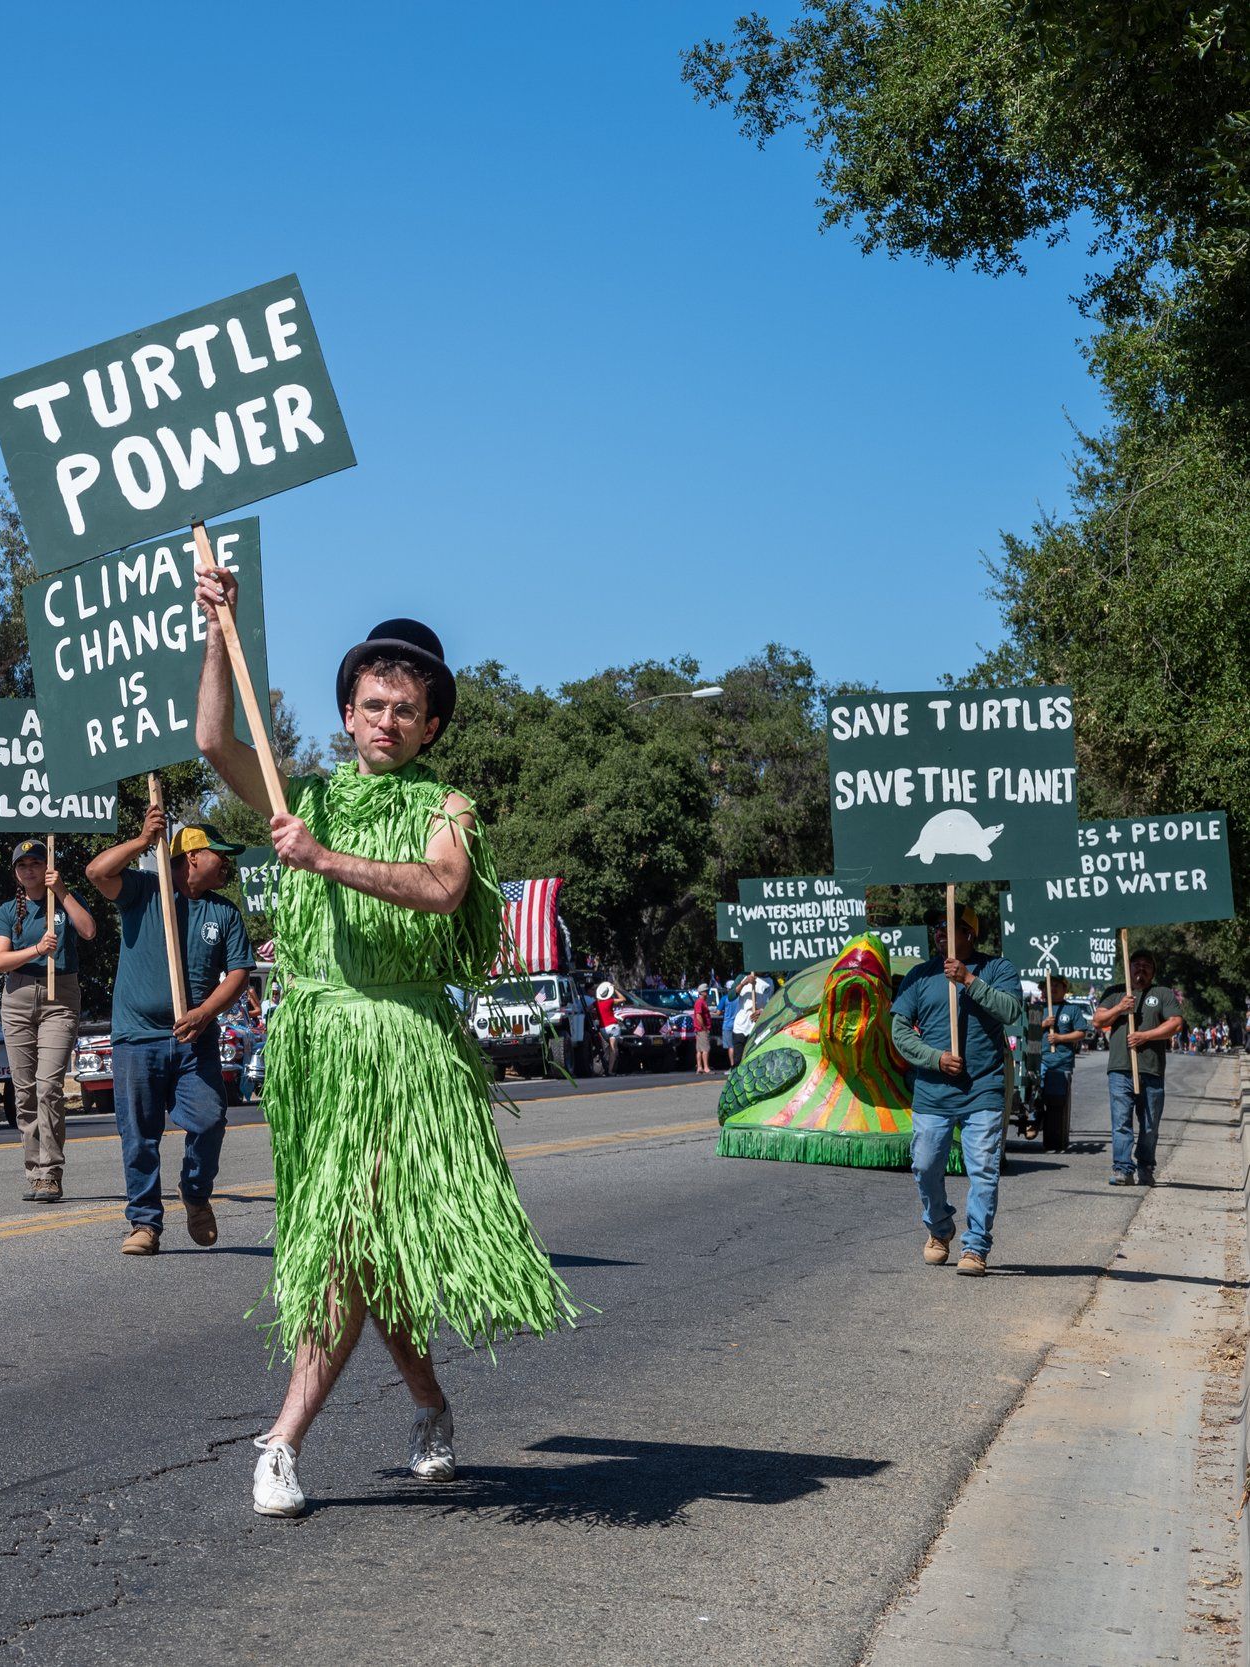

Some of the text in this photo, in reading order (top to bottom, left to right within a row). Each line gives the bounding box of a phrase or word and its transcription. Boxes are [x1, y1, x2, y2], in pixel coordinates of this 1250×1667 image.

[13, 298, 301, 443] TURTLE
[56, 384, 324, 535] POWER
[44, 533, 239, 627] CLIMATE
[54, 601, 207, 681] CHANGE
[119, 671, 148, 707] IS
[86, 698, 188, 757] REAL
[831, 697, 1072, 741] SAVE TURTLES
[835, 766, 1076, 810] SAVE THE PLANET
[1131, 820, 1221, 843] PEOPLE
[1081, 850, 1145, 875] BOTH
[763, 880, 808, 899] KEEP
[1046, 868, 1208, 901] NEED WATER
[741, 898, 867, 922] WATERSHED HEALTHY
[767, 915, 850, 935] TO KEEP US
[1058, 966, 1113, 981] TURTLES
